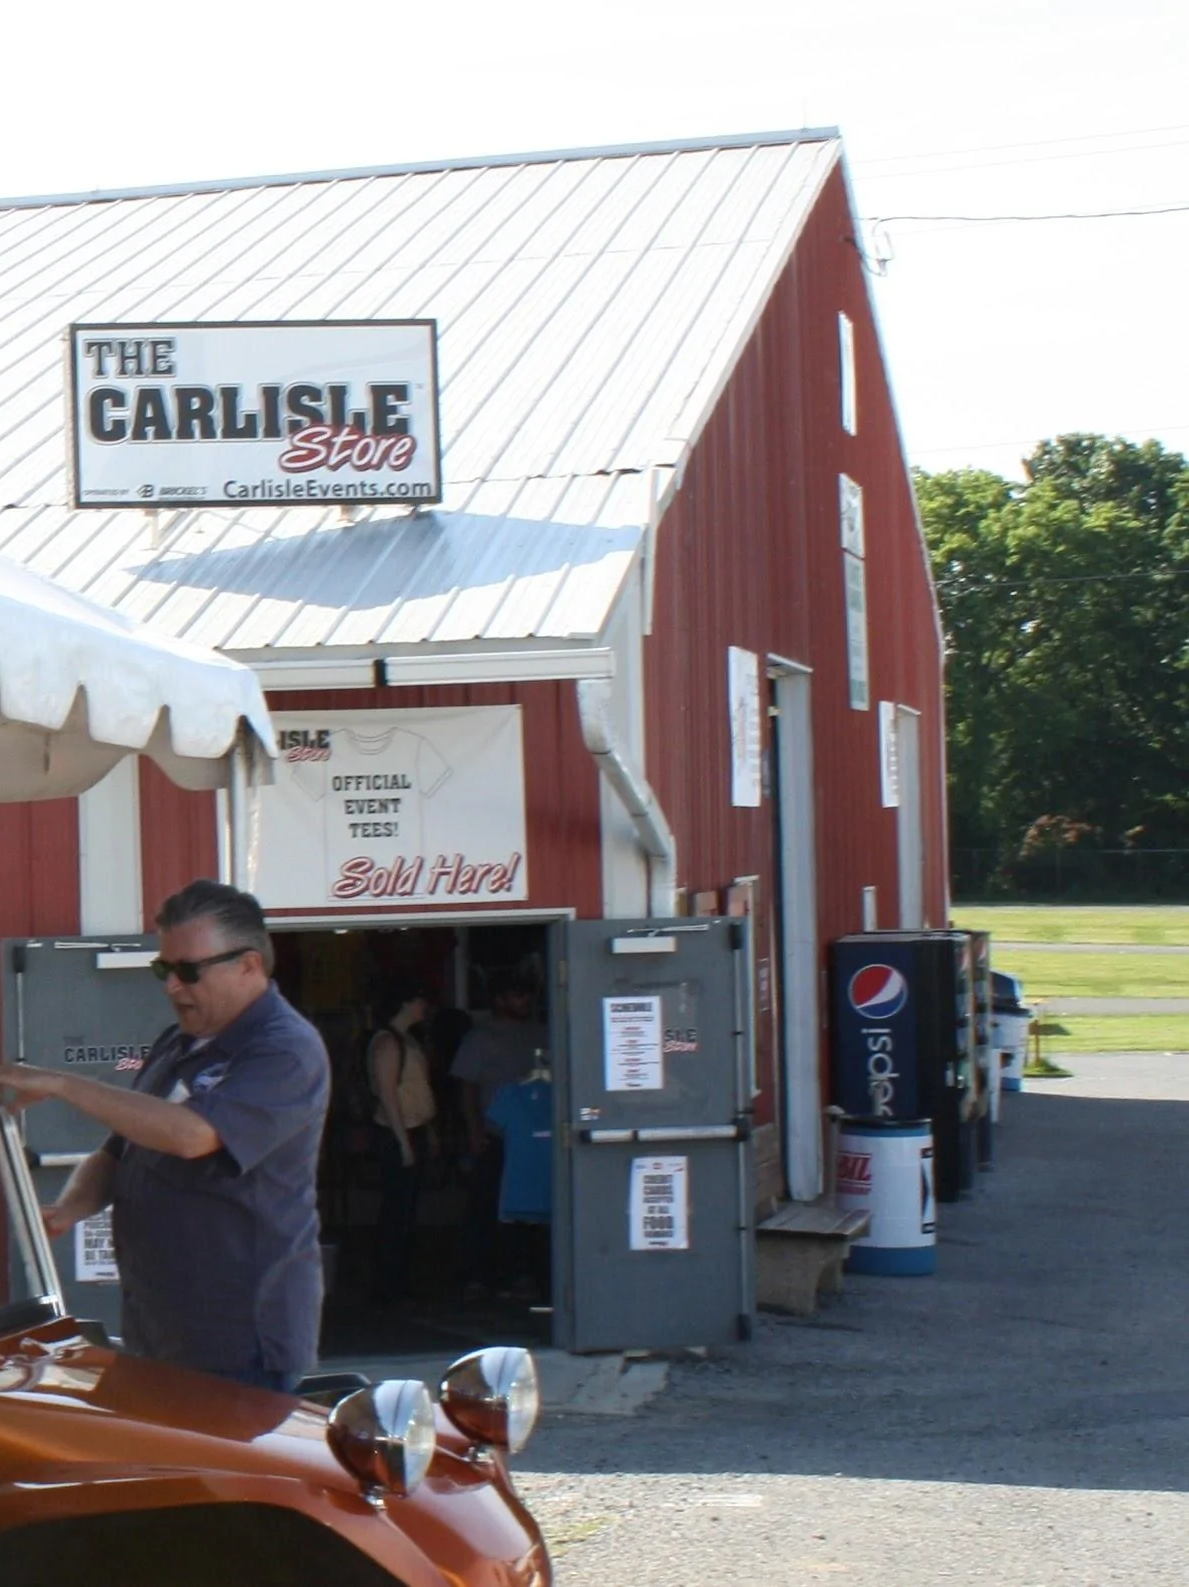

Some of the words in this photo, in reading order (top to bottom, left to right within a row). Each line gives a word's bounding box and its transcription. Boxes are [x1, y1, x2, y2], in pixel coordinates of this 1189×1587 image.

[83, 336, 176, 378] THE
[88, 381, 410, 444] CARLISLE
[278, 424, 416, 472] Store
[223, 480, 432, 499] CarlisleEvents.com
[279, 729, 330, 750] ISLE
[332, 773, 412, 792] OFFICIAL
[344, 798, 401, 815] EVENT
[348, 821, 399, 838] TEES!
[332, 854, 425, 899] Sold
[428, 851, 522, 895] Here!
